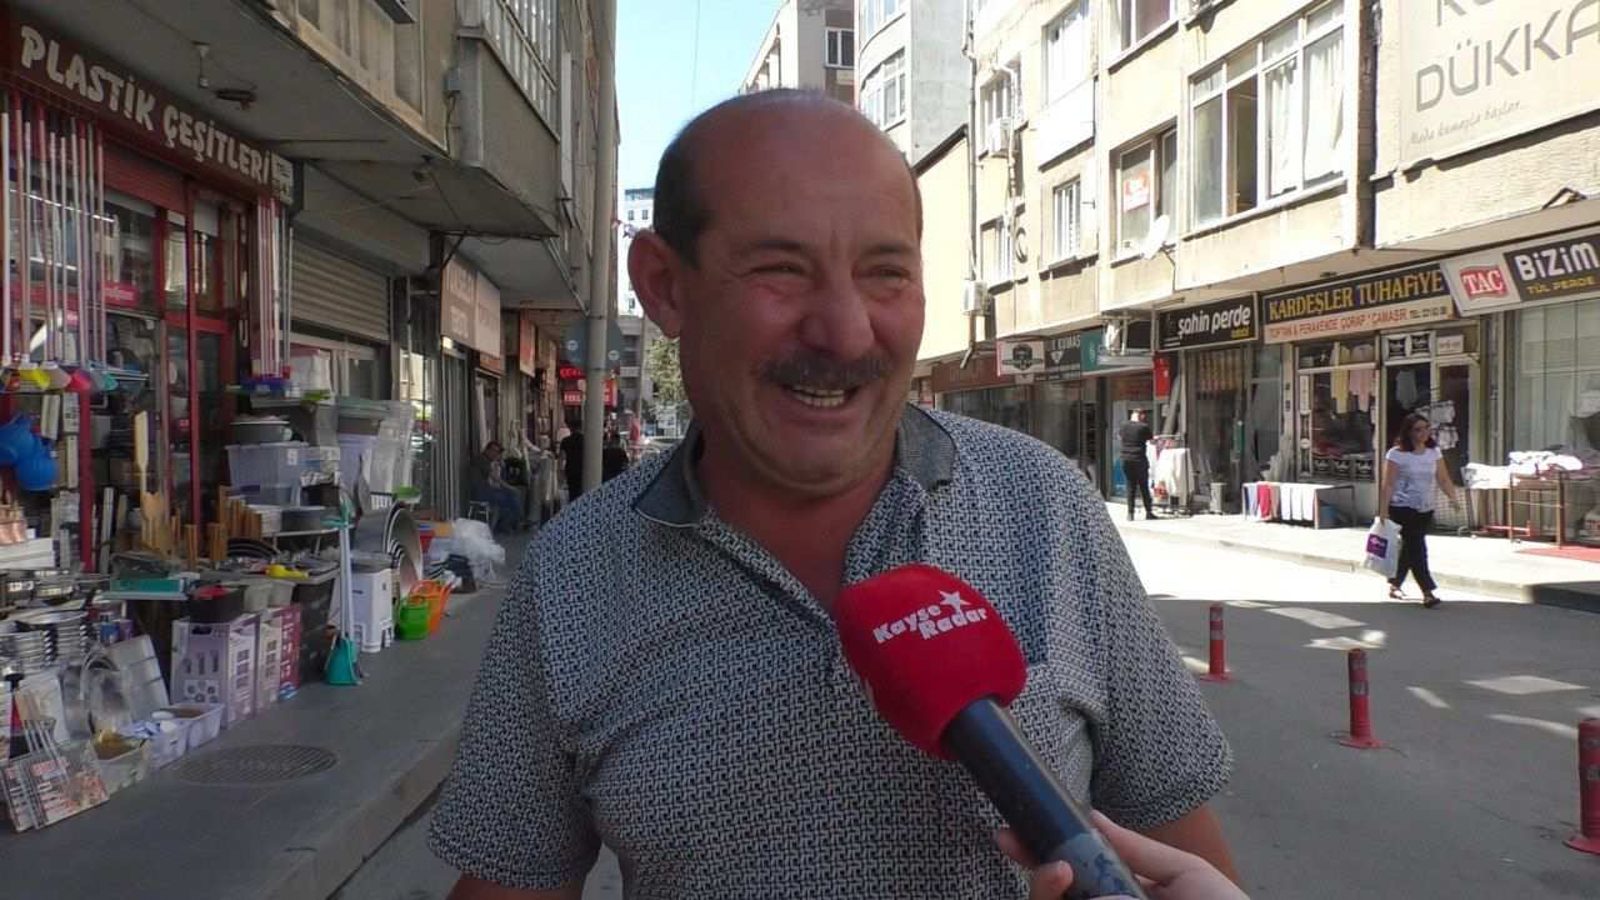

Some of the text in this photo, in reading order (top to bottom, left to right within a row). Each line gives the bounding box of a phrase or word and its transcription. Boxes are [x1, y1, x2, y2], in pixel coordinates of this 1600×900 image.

[20, 25, 156, 131] PLASTİK
[162, 104, 271, 185] ÇEŞİTLERİ
[1211, 304, 1251, 334] perde
[1269, 287, 1353, 321] KARDEŞLER
[918, 607, 987, 641] Radar
